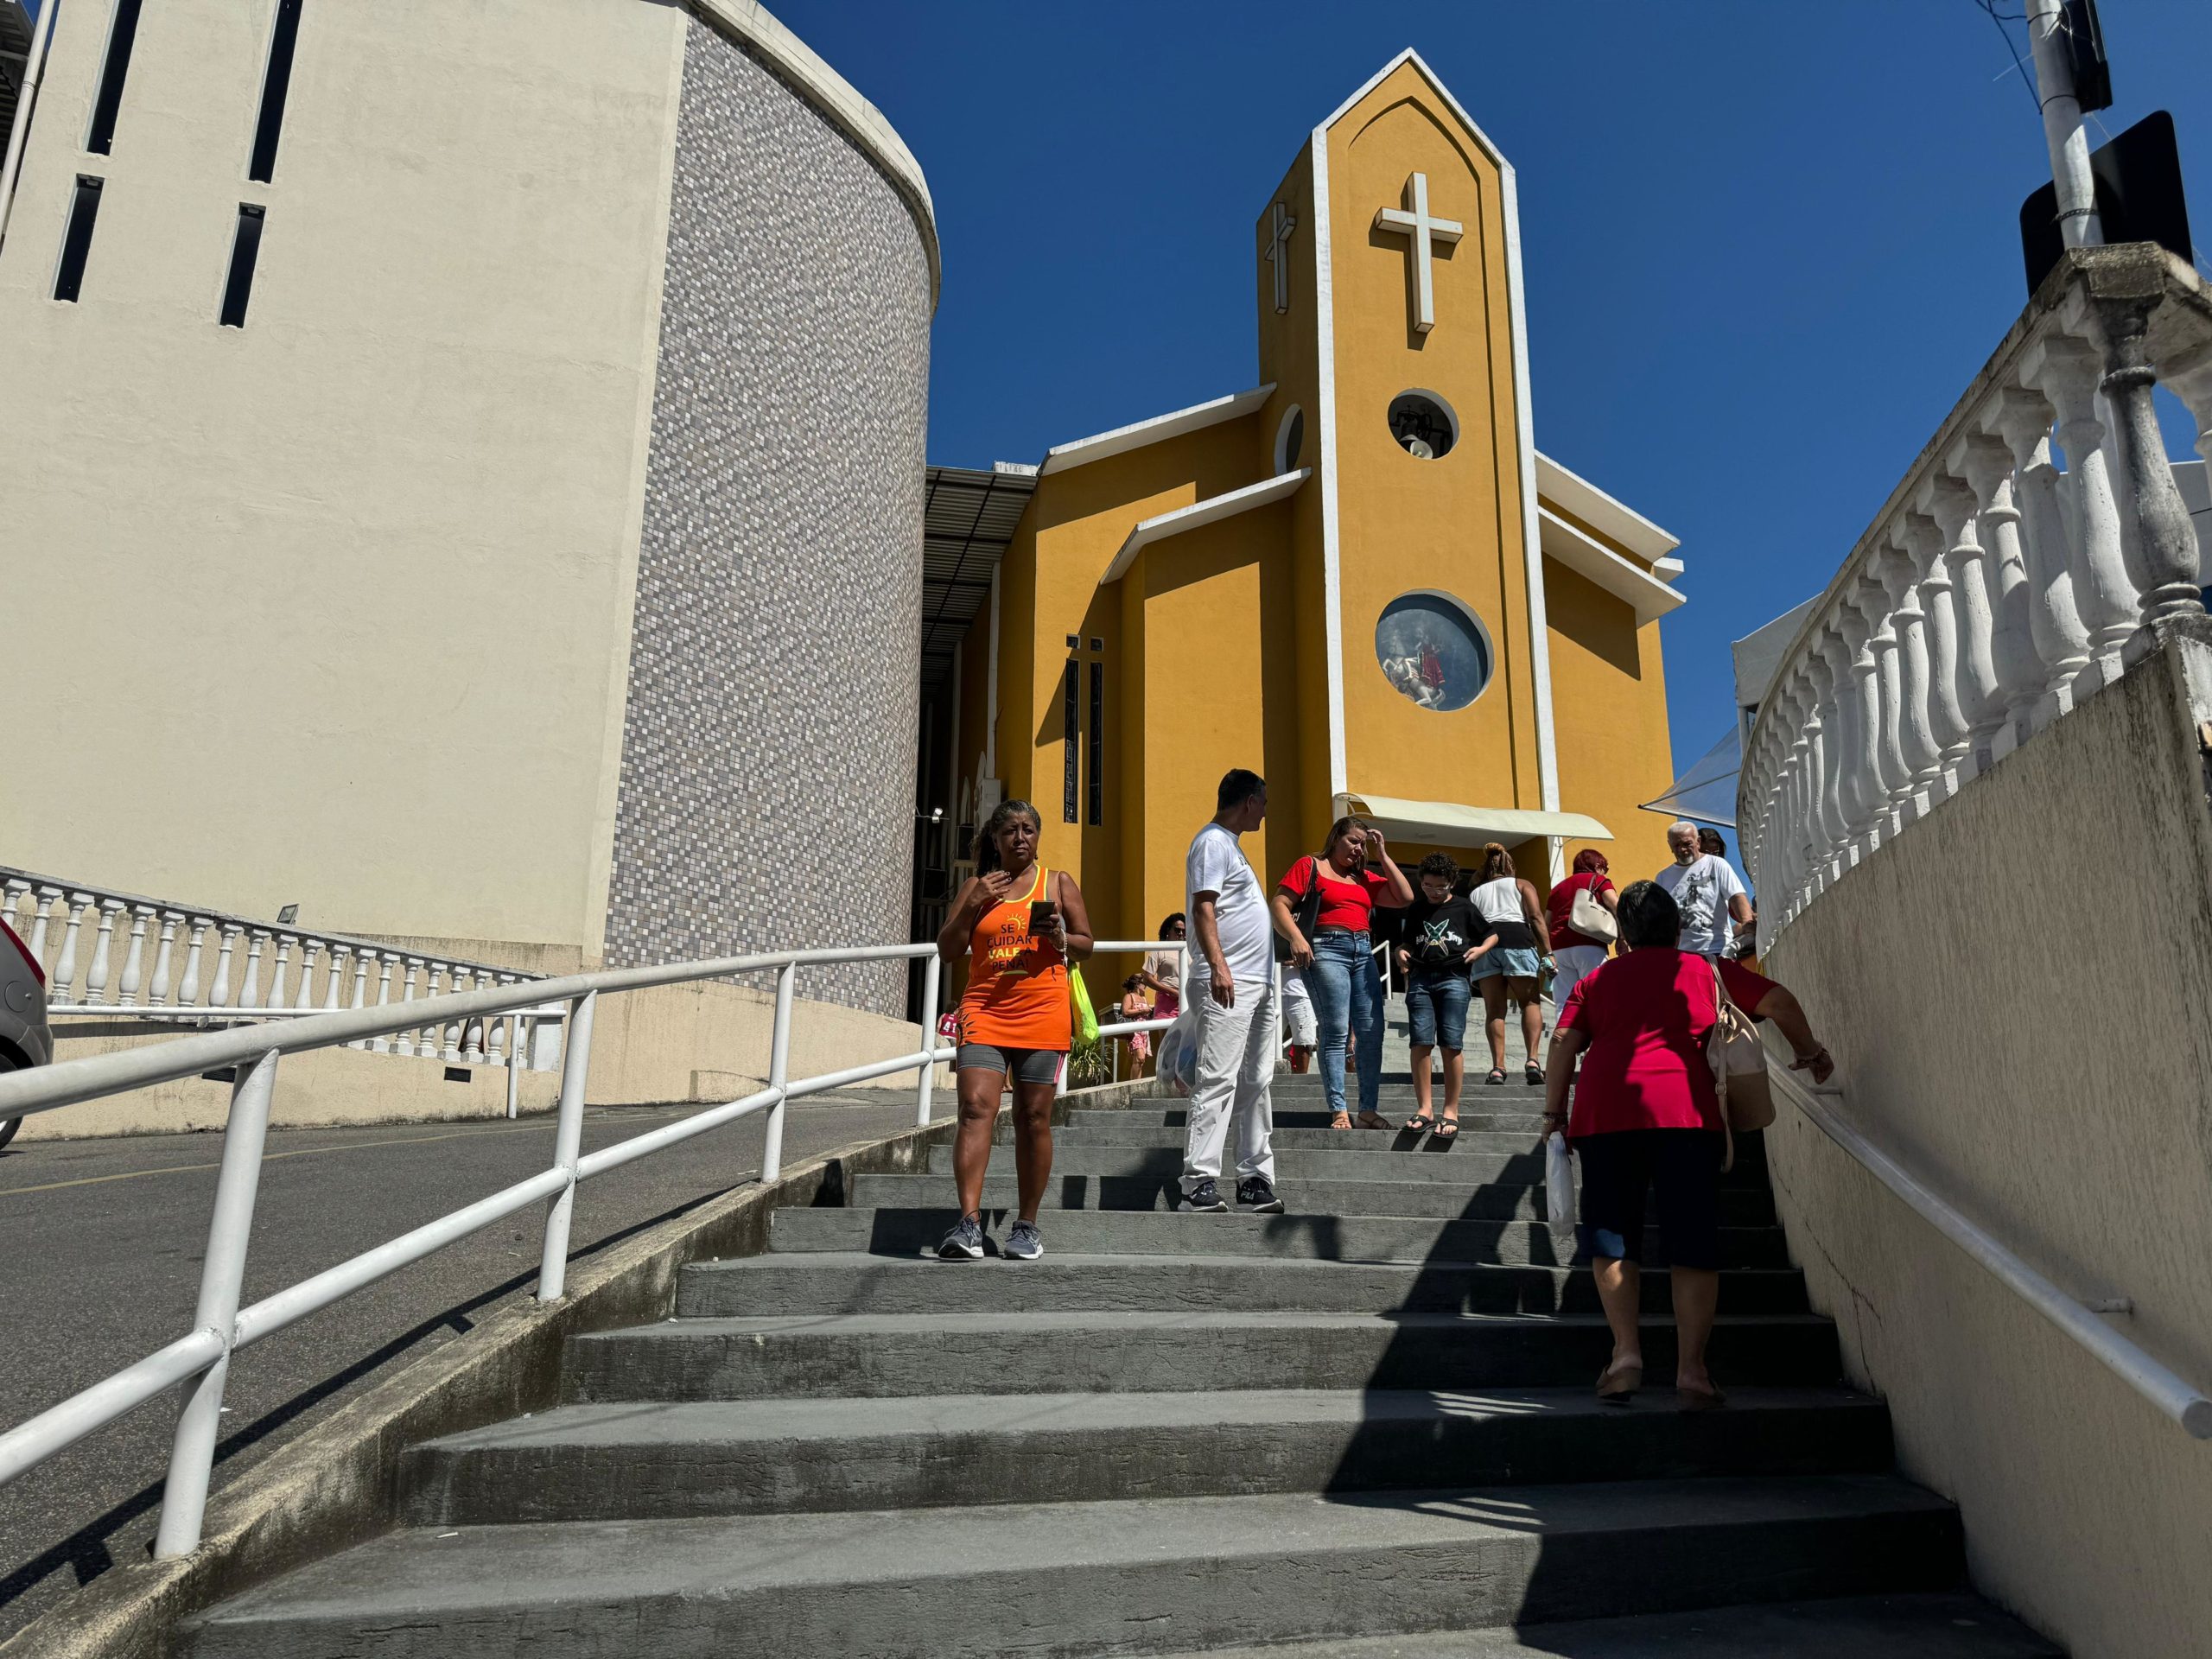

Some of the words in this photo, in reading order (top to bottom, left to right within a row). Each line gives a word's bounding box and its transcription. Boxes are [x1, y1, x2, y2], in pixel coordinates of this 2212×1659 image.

[1001, 924, 1014, 934] SE
[988, 935, 1032, 948] CUIDAR
[988, 947, 1020, 959] VALE
[1241, 1191, 1254, 1200] FILA
